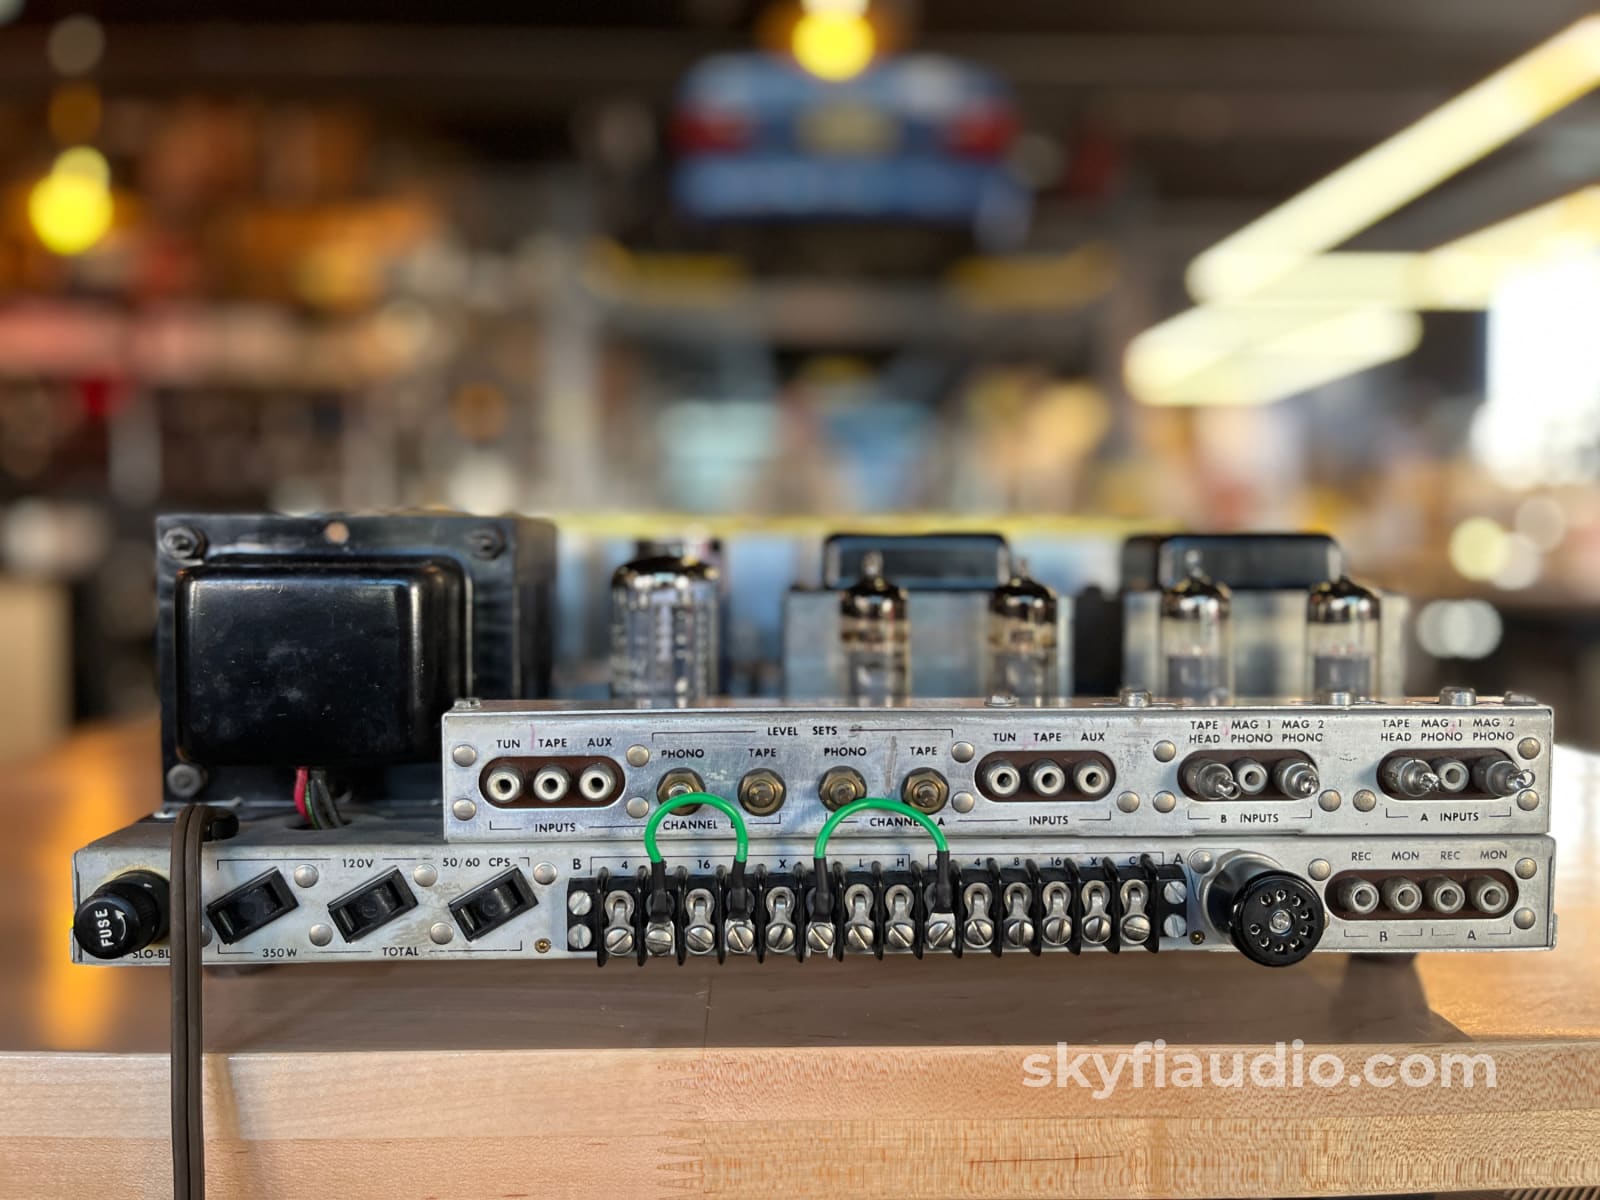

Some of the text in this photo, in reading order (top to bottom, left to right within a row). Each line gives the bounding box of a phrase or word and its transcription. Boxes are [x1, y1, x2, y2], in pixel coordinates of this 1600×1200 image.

[1190, 720, 1325, 730] TAPE MAG 1 MAG 2
[1382, 718, 1515, 728] TAPE MAG 1 MAG 2
[767, 726, 837, 736] LEVEL SETS
[993, 732, 1105, 742] TUN TAPE AUX
[1189, 734, 1220, 744] HEAD
[1231, 733, 1273, 743] PHONO
[1381, 731, 1515, 742] HEAD PHONO PHONO
[496, 738, 612, 749] TUN TAPE AUX
[661, 748, 776, 759] PHONO TAPE
[824, 746, 937, 756] PHONO TAPE
[870, 817, 945, 827] CHANNE A
[1029, 815, 1068, 825] INPUTS
[1220, 813, 1279, 823] B INPUTS
[1420, 812, 1479, 822] A INPUTS
[535, 823, 576, 832] INPUTS
[663, 820, 717, 830] CHANNEL
[1351, 850, 1508, 862] REC MON REC MON
[342, 858, 374, 868] 120V
[442, 857, 511, 868] 50/60 CPS
[572, 853, 1183, 870] B 4 16 X L H 4 8 16 X C A
[95, 908, 114, 947] FUSE
[1380, 931, 1388, 942] B
[1467, 930, 1477, 941] A
[132, 949, 171, 959] SLO-BL
[382, 947, 419, 957] TOTAL
